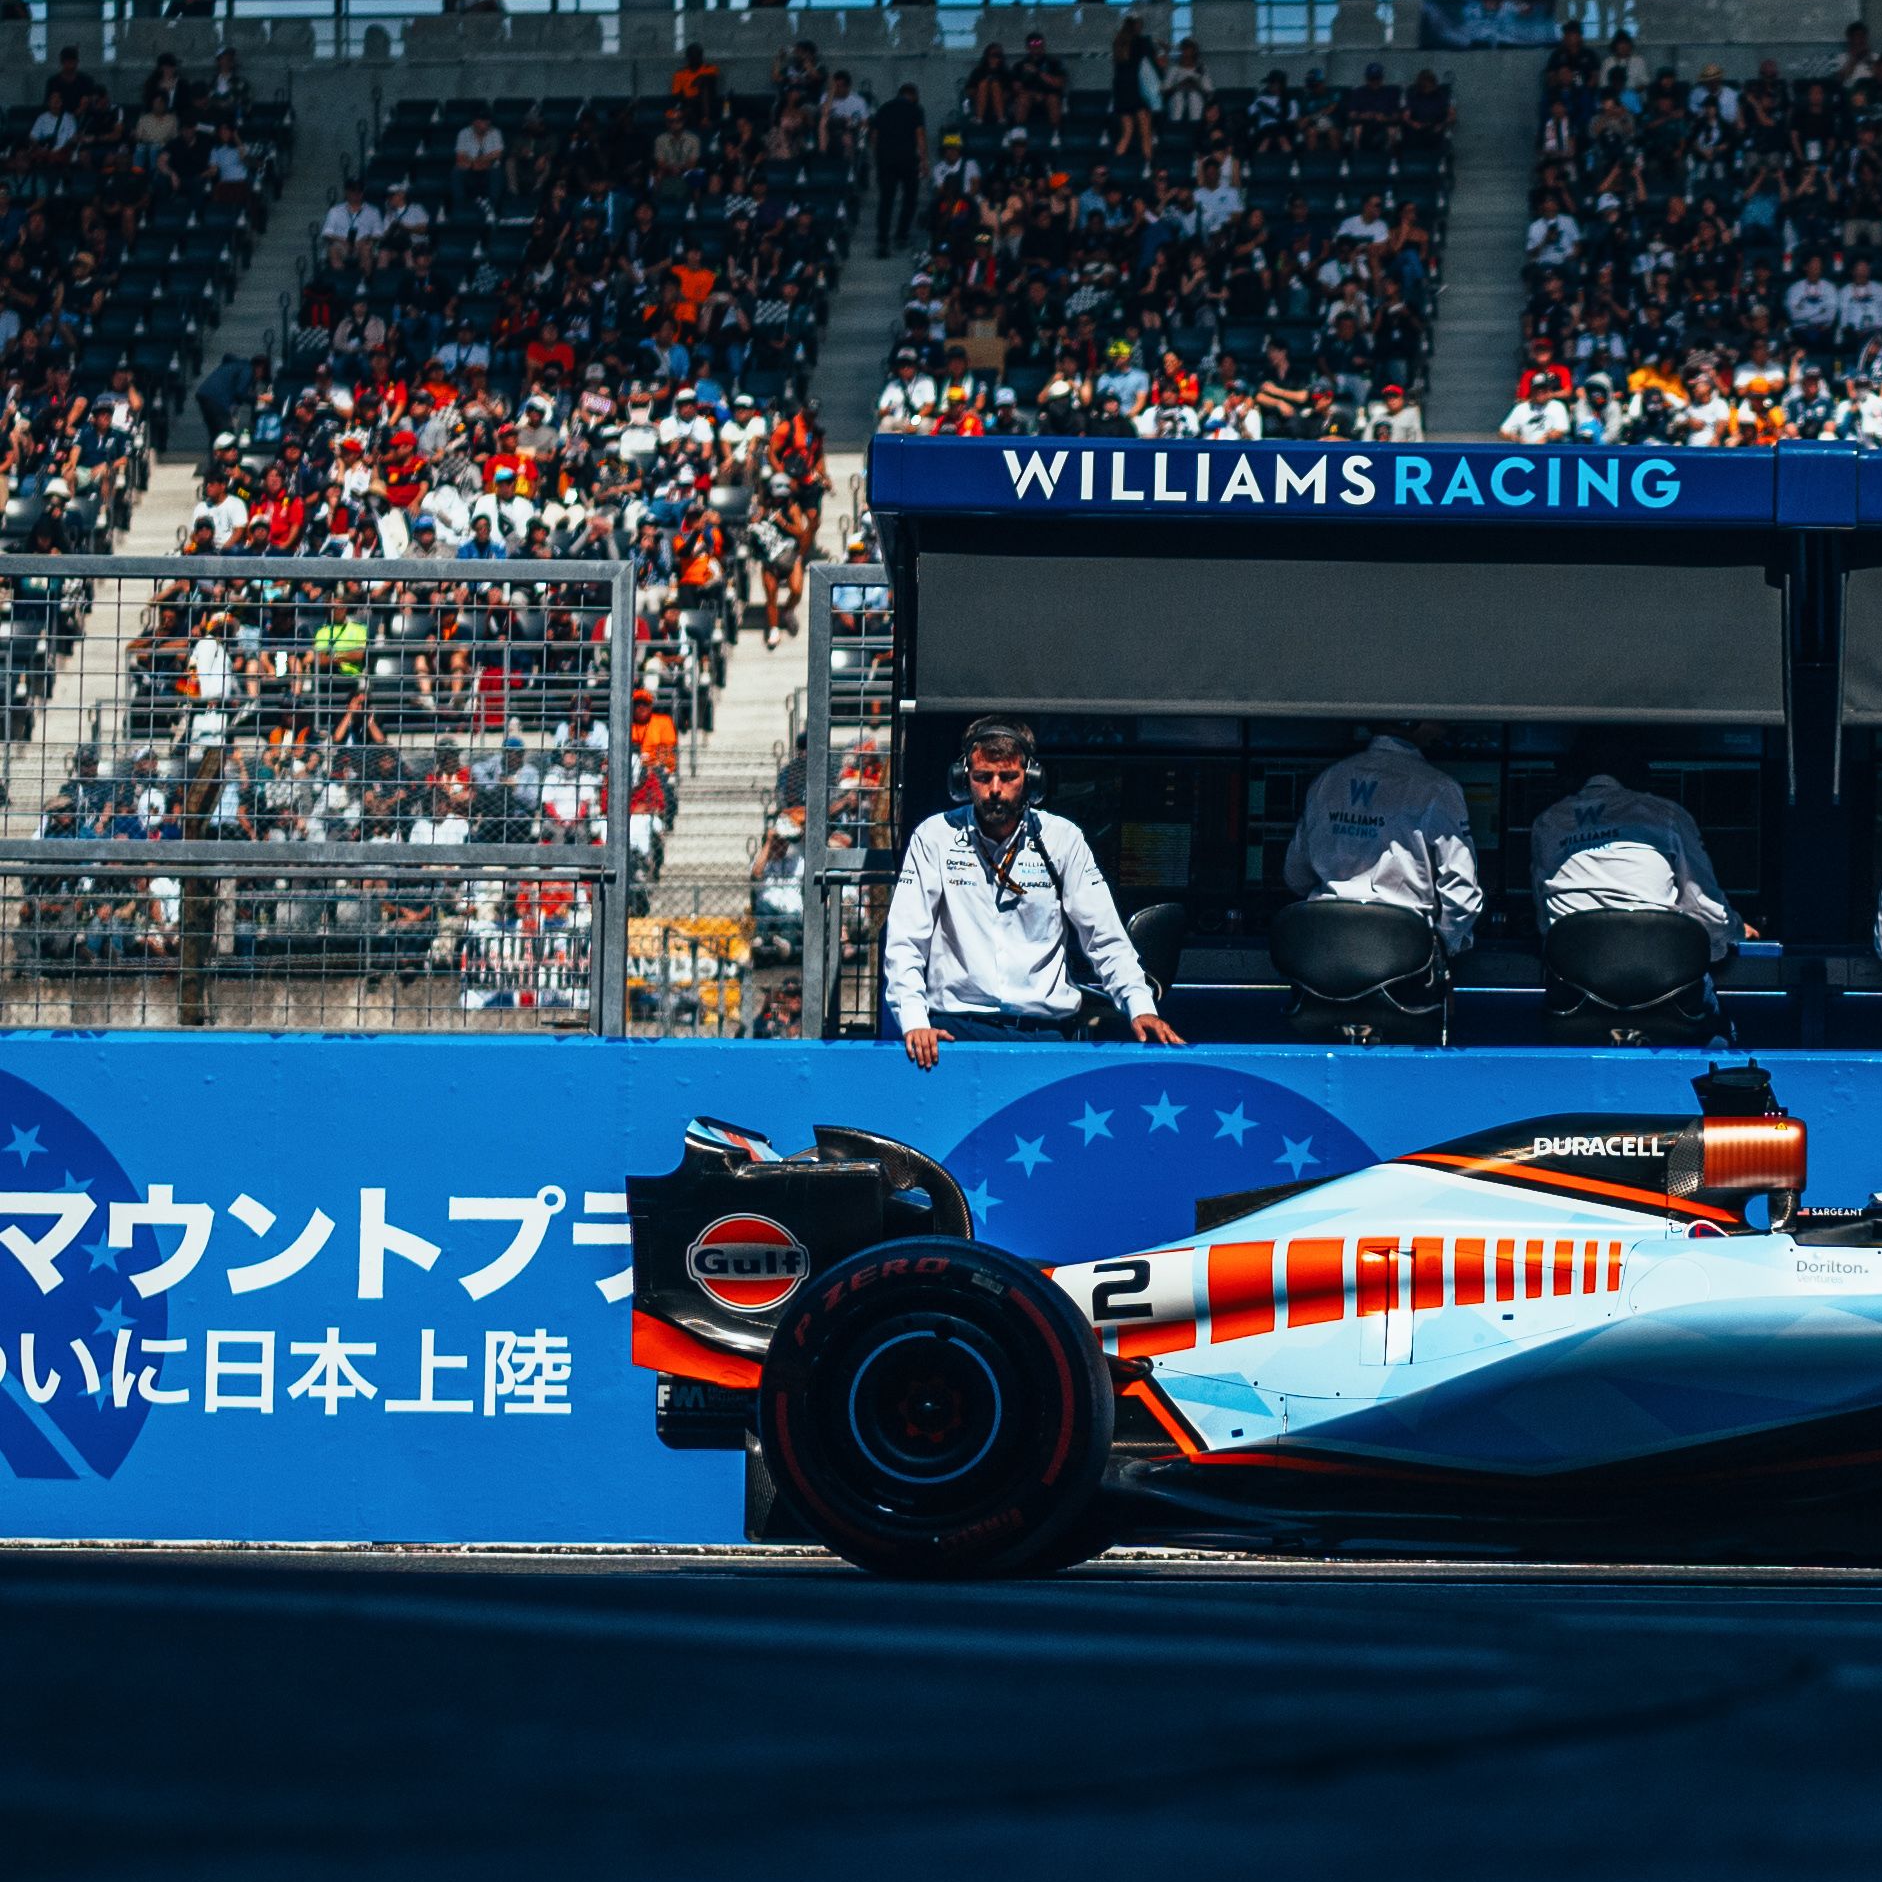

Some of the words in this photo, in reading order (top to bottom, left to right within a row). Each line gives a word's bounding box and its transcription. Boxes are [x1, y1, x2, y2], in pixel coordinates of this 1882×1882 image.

[1003, 450, 1376, 506] WILLIAMS
[1395, 456, 1682, 508] RACING
[1328, 811, 1386, 827] WILLIAMS
[1332, 824, 1379, 839] RACING
[1559, 828, 1620, 846] WILLIAMS
[1533, 1136, 1665, 1158] DURACELL
[1811, 1207, 1864, 1217] SARGEANT
[694, 1248, 801, 1274] Gulf
[822, 1257, 950, 1312] ZERO
[1092, 1260, 1154, 1321] 2
[0, 1327, 572, 1416] いに日本上陸
